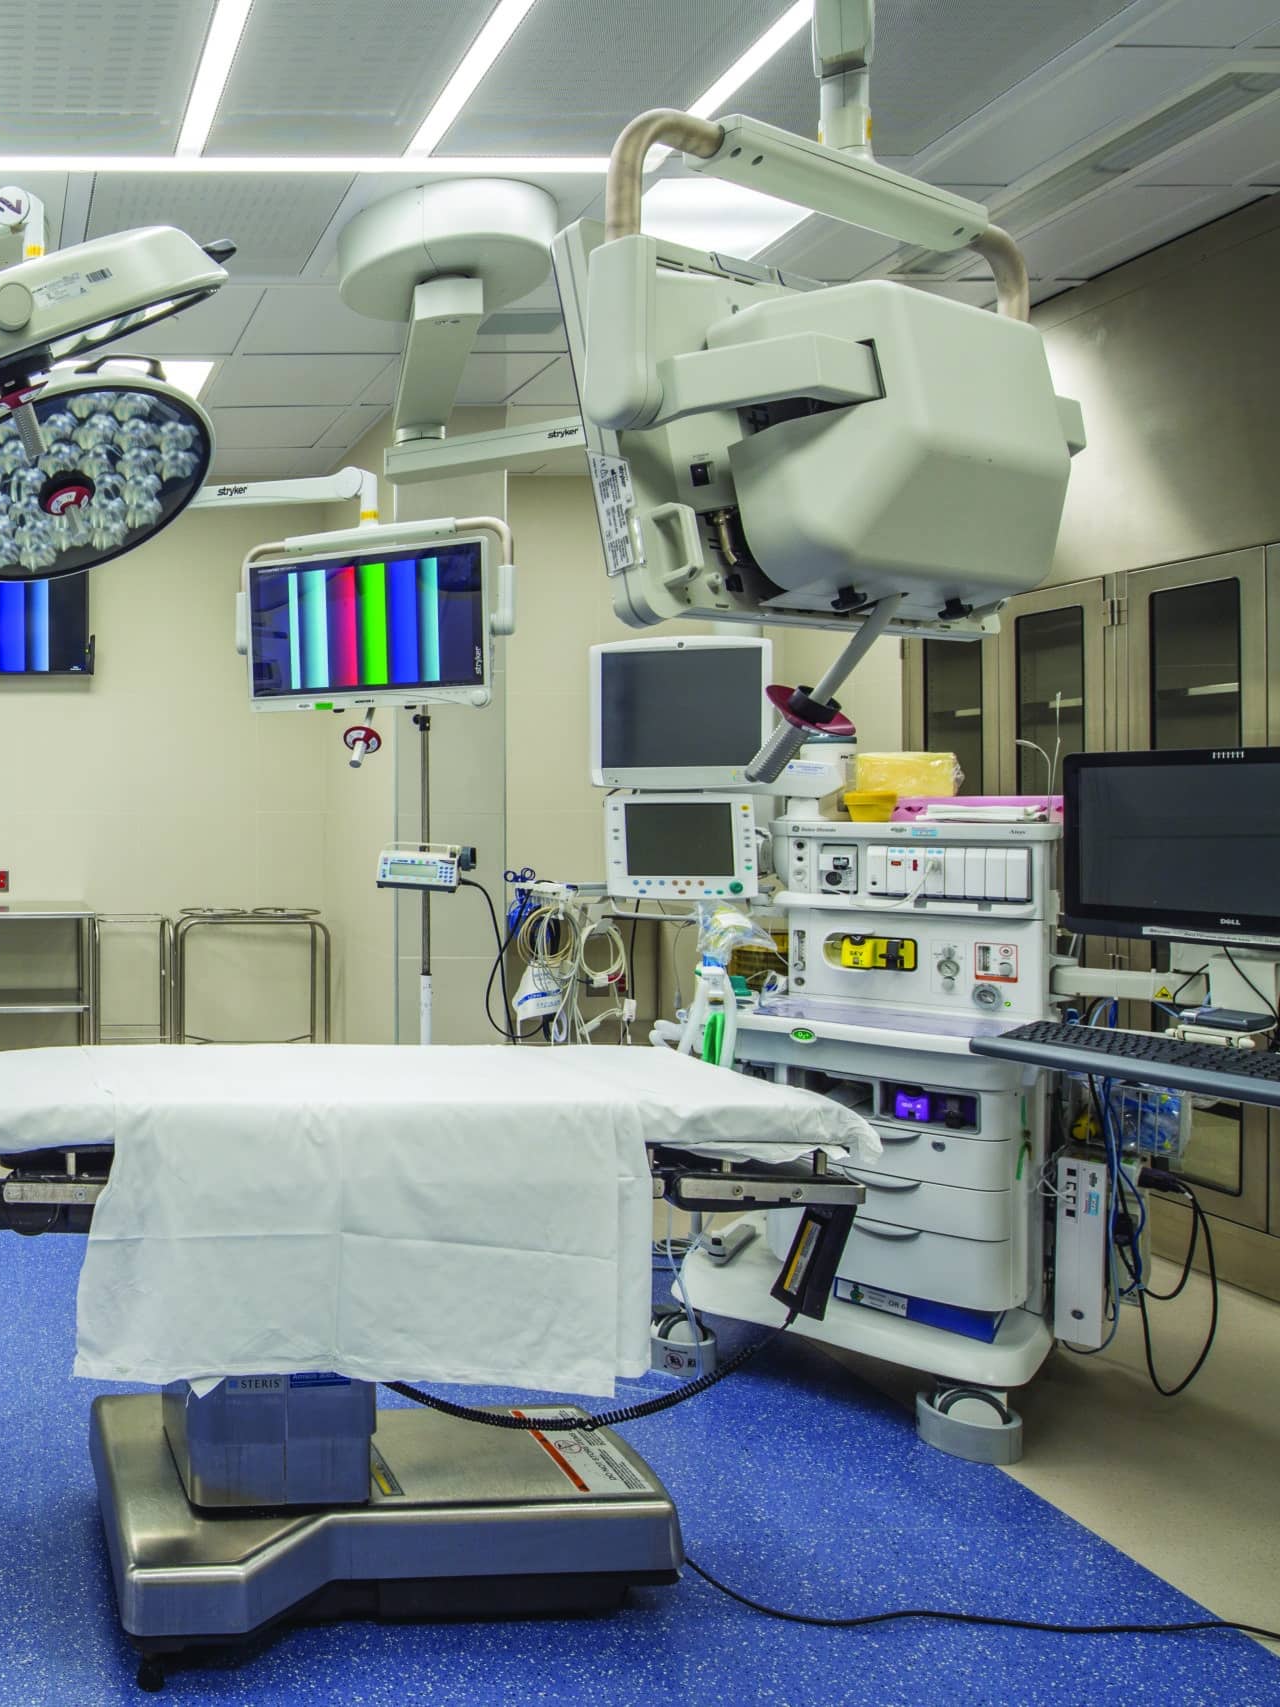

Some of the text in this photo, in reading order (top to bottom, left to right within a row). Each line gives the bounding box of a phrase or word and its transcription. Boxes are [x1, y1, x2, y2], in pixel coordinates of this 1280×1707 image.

[547, 428, 579, 439] stryker
[217, 485, 248, 497] stryker
[1220, 918, 1241, 926] DELL
[240, 1379, 280, 1389] STERIS
